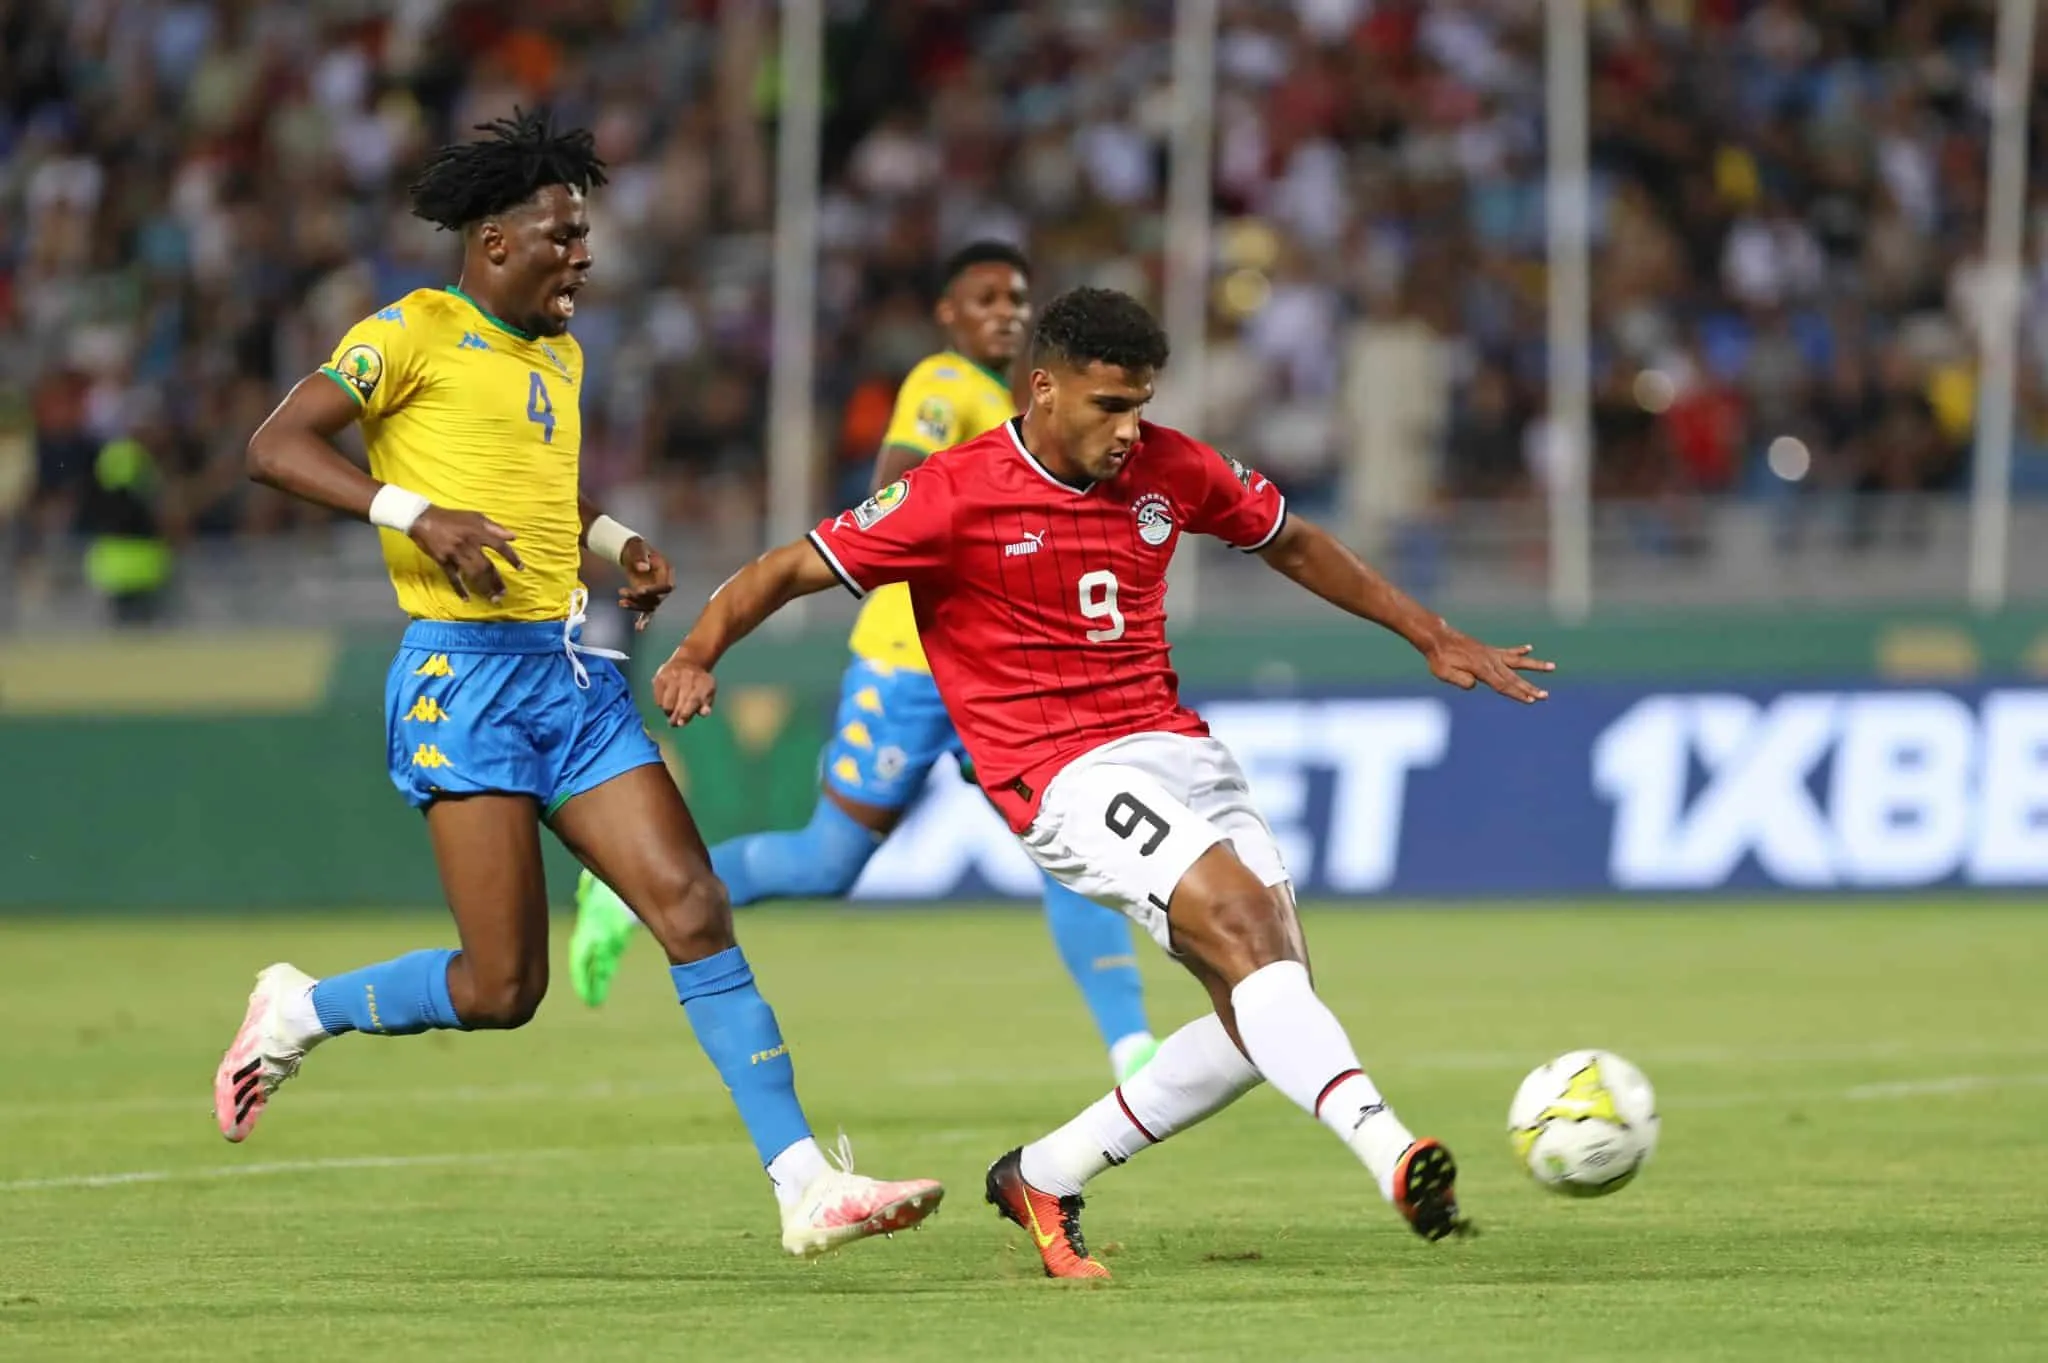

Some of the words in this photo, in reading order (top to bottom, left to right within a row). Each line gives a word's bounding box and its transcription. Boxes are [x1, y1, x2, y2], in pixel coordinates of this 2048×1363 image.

[528, 371, 556, 444] 4
[1005, 540, 1038, 557] PUMA
[1078, 569, 1125, 643] 9
[1104, 791, 1171, 857] 9
